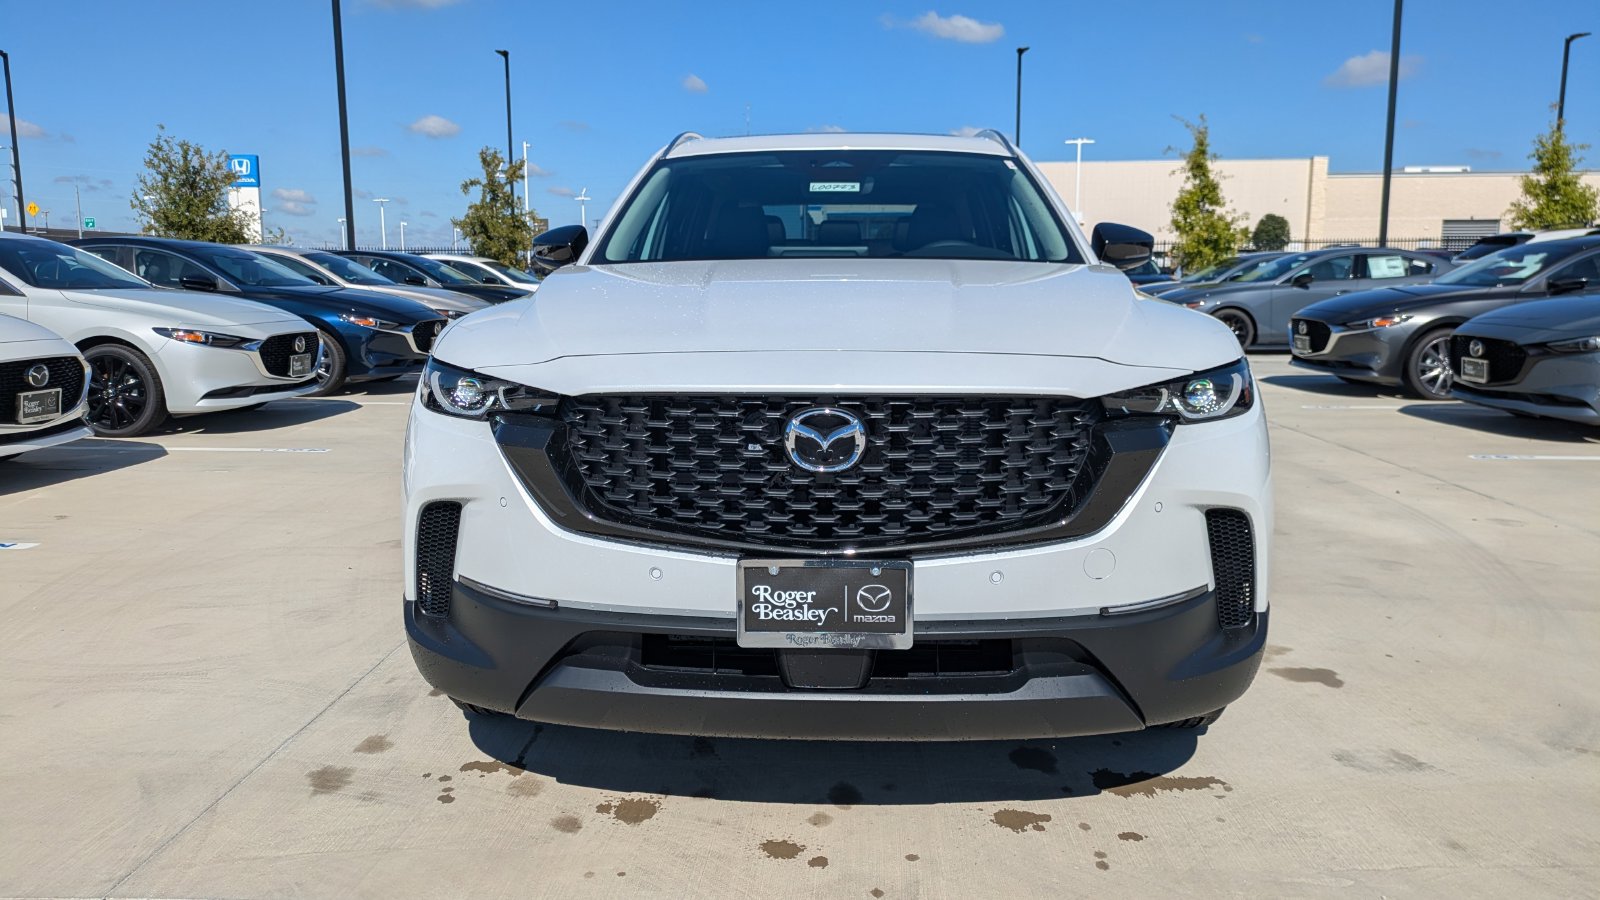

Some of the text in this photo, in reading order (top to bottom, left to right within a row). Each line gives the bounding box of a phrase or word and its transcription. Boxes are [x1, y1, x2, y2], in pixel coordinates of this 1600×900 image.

[752, 585, 817, 608] Roger
[752, 603, 839, 626] Beasley
[853, 615, 896, 623] mazda
[785, 633, 819, 646] Roger
